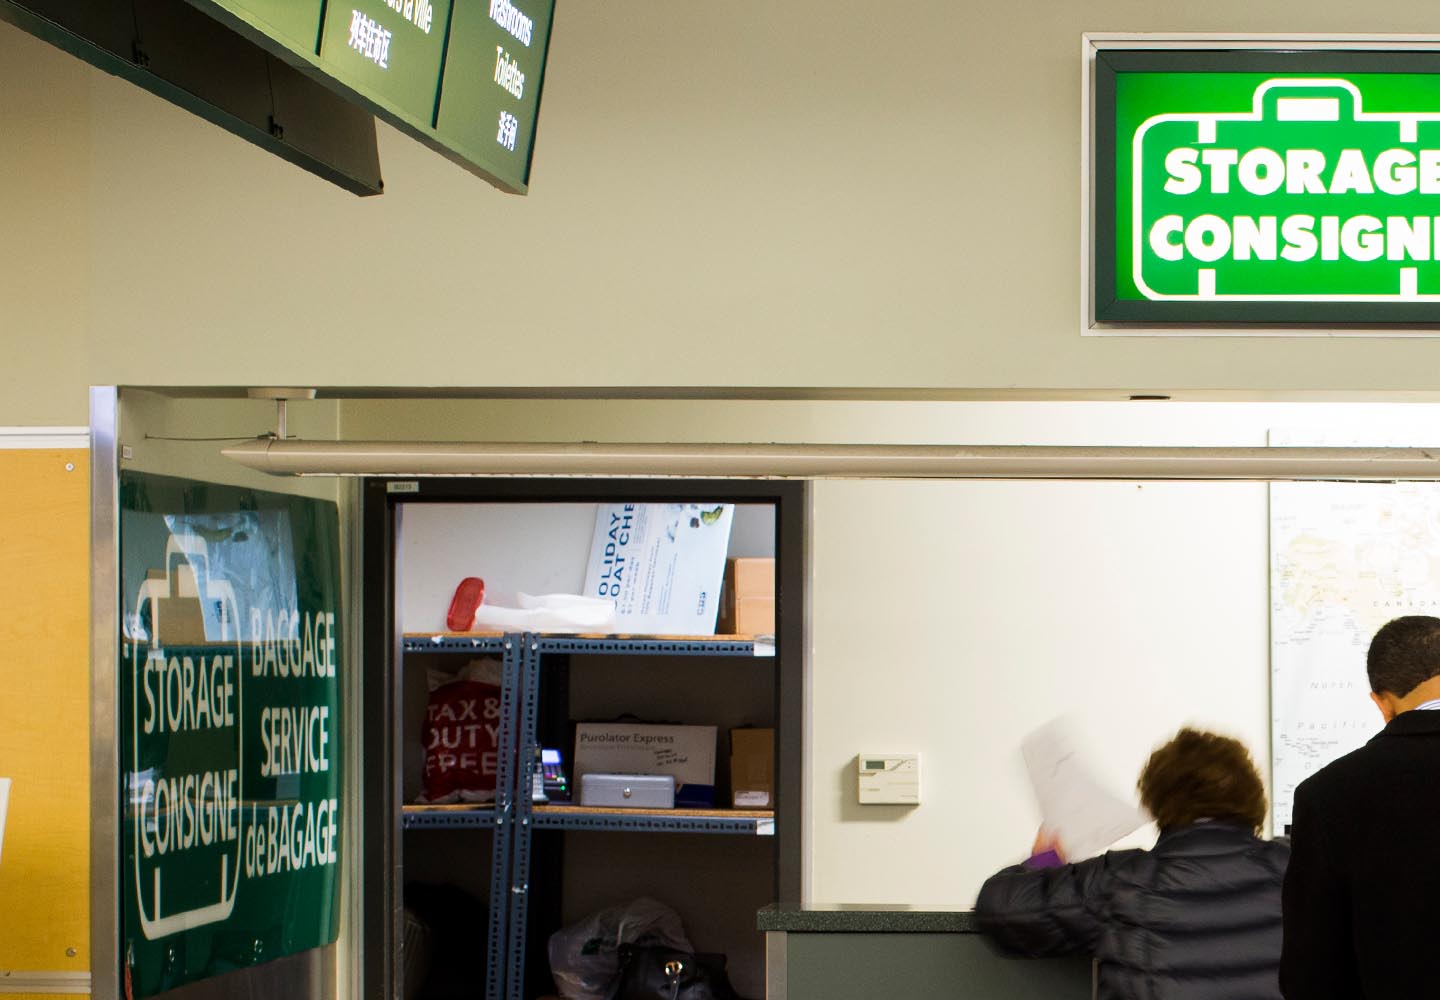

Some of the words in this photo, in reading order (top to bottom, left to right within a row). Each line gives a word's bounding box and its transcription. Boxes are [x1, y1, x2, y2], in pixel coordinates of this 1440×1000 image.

[494, 46, 525, 99] Toilettes
[610, 554, 626, 608] OAT
[250, 607, 336, 678] BAGGAGE
[142, 655, 235, 735] STORAGE
[427, 699, 478, 722] TAX
[482, 697, 500, 720] &
[260, 705, 330, 777] SERVICE
[580, 732, 631, 744] Purolator
[633, 733, 675, 745] Express
[140, 768, 238, 858] CONSIGNE
[244, 801, 266, 880] de
[266, 798, 338, 874] BAGAGE
